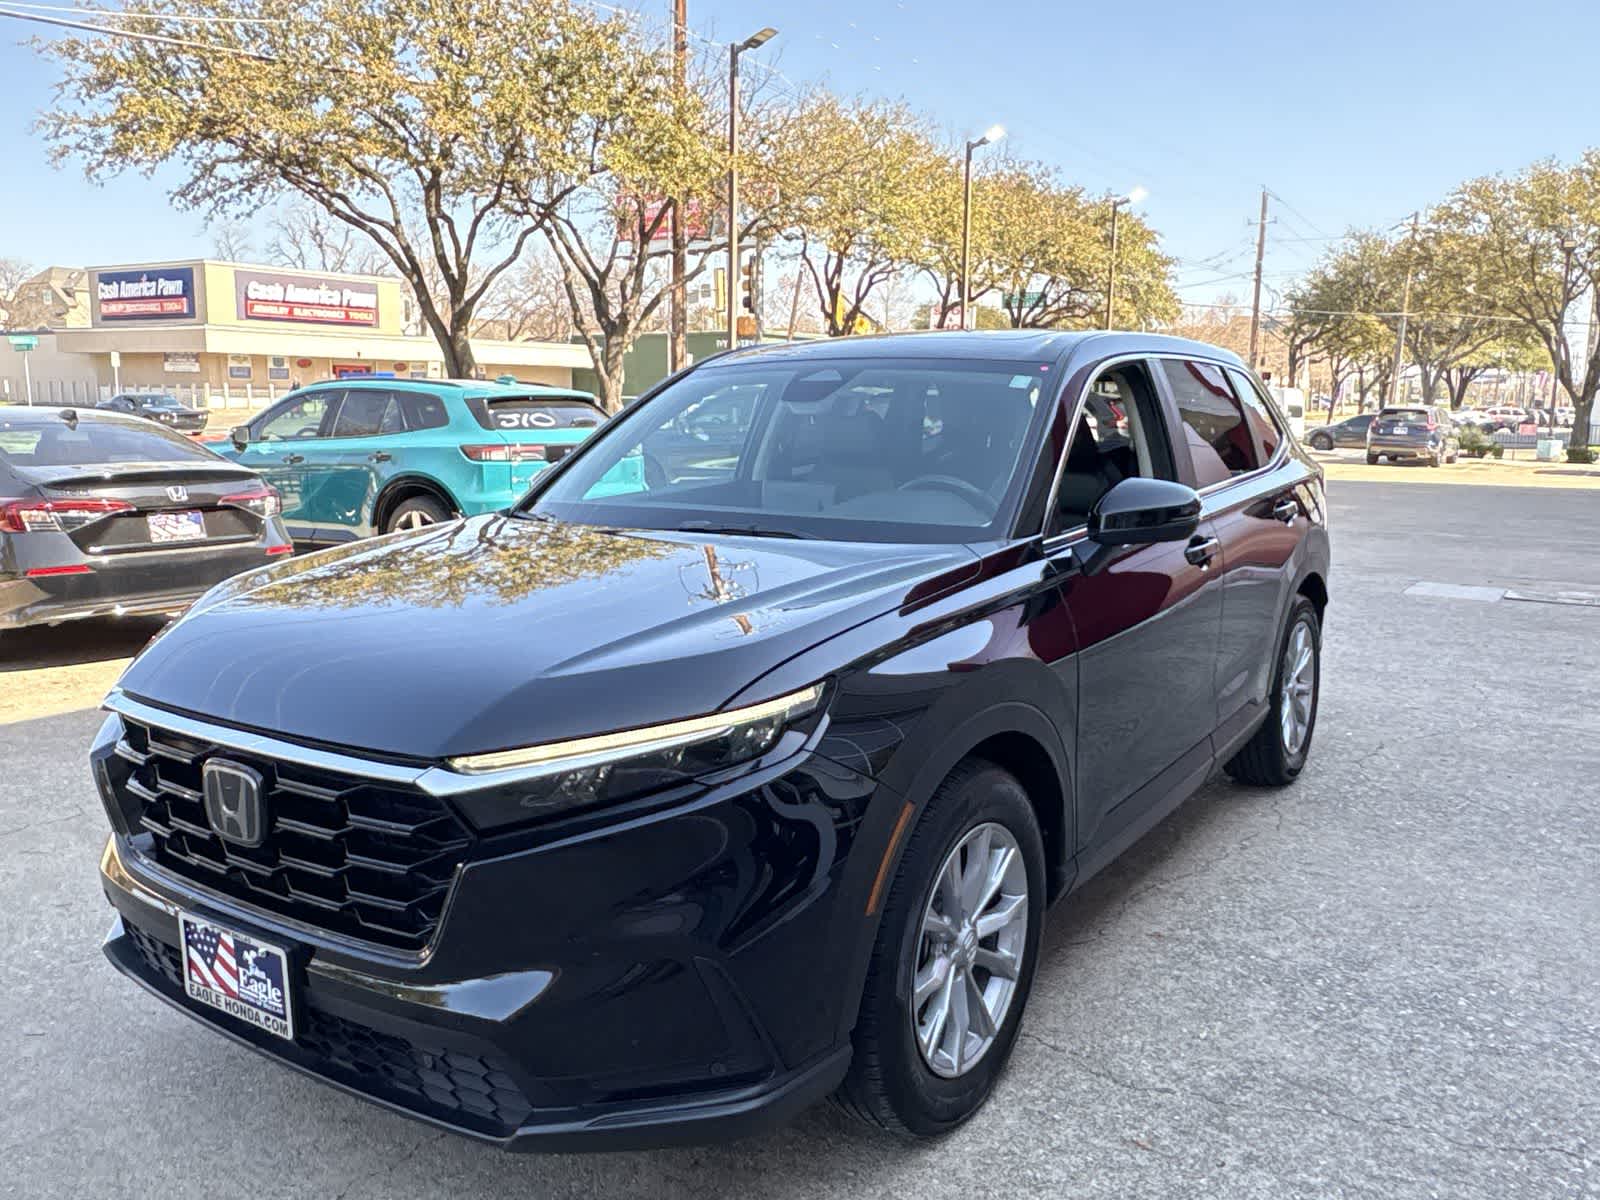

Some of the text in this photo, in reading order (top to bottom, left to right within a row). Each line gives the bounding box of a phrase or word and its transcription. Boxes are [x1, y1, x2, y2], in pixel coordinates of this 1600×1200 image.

[98, 278, 183, 299] Cash America Pawn
[247, 281, 376, 308] Cash America Pawn
[238, 966, 282, 1003] Eagle
[189, 984, 224, 1007] EAGLE
[225, 998, 289, 1036] HONDA.COM
